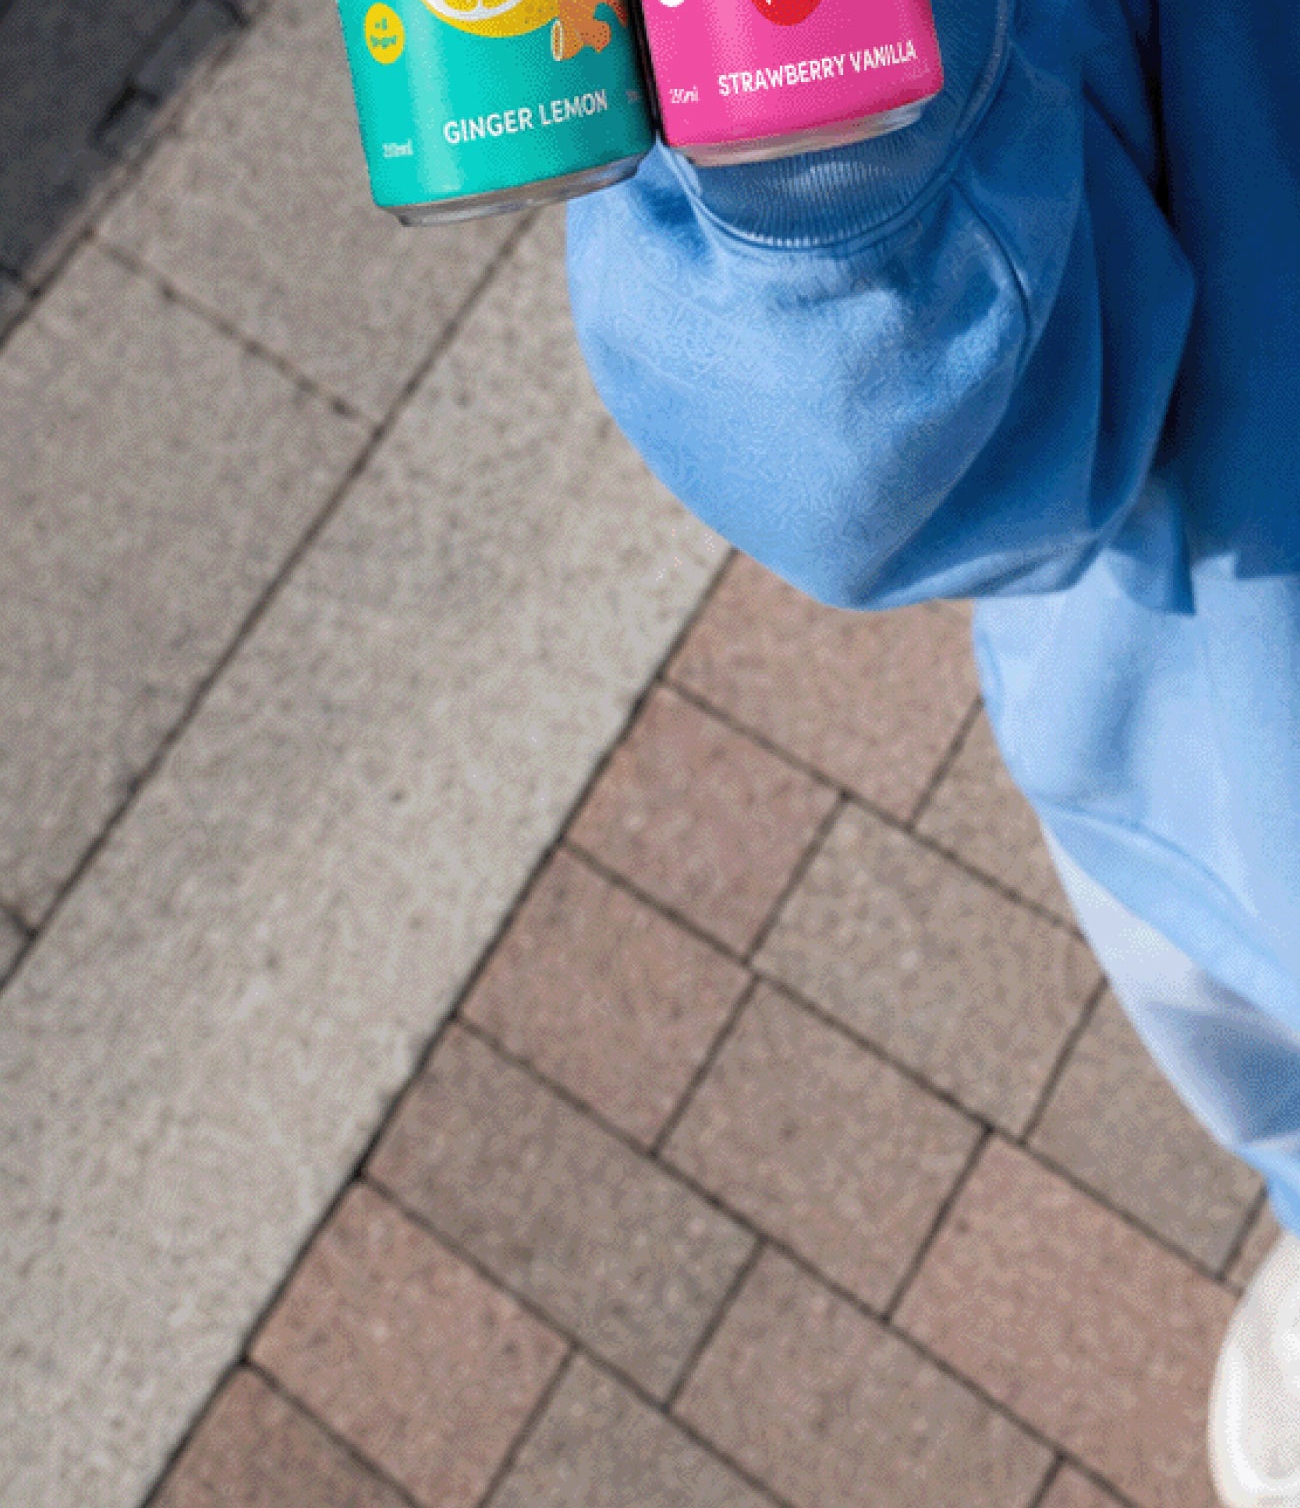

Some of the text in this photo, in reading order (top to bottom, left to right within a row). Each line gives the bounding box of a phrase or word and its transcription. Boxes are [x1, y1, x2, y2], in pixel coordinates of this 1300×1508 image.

[718, 39, 917, 97] STRAWBERRY VANILLA
[444, 88, 608, 144] GINGER LEMON
